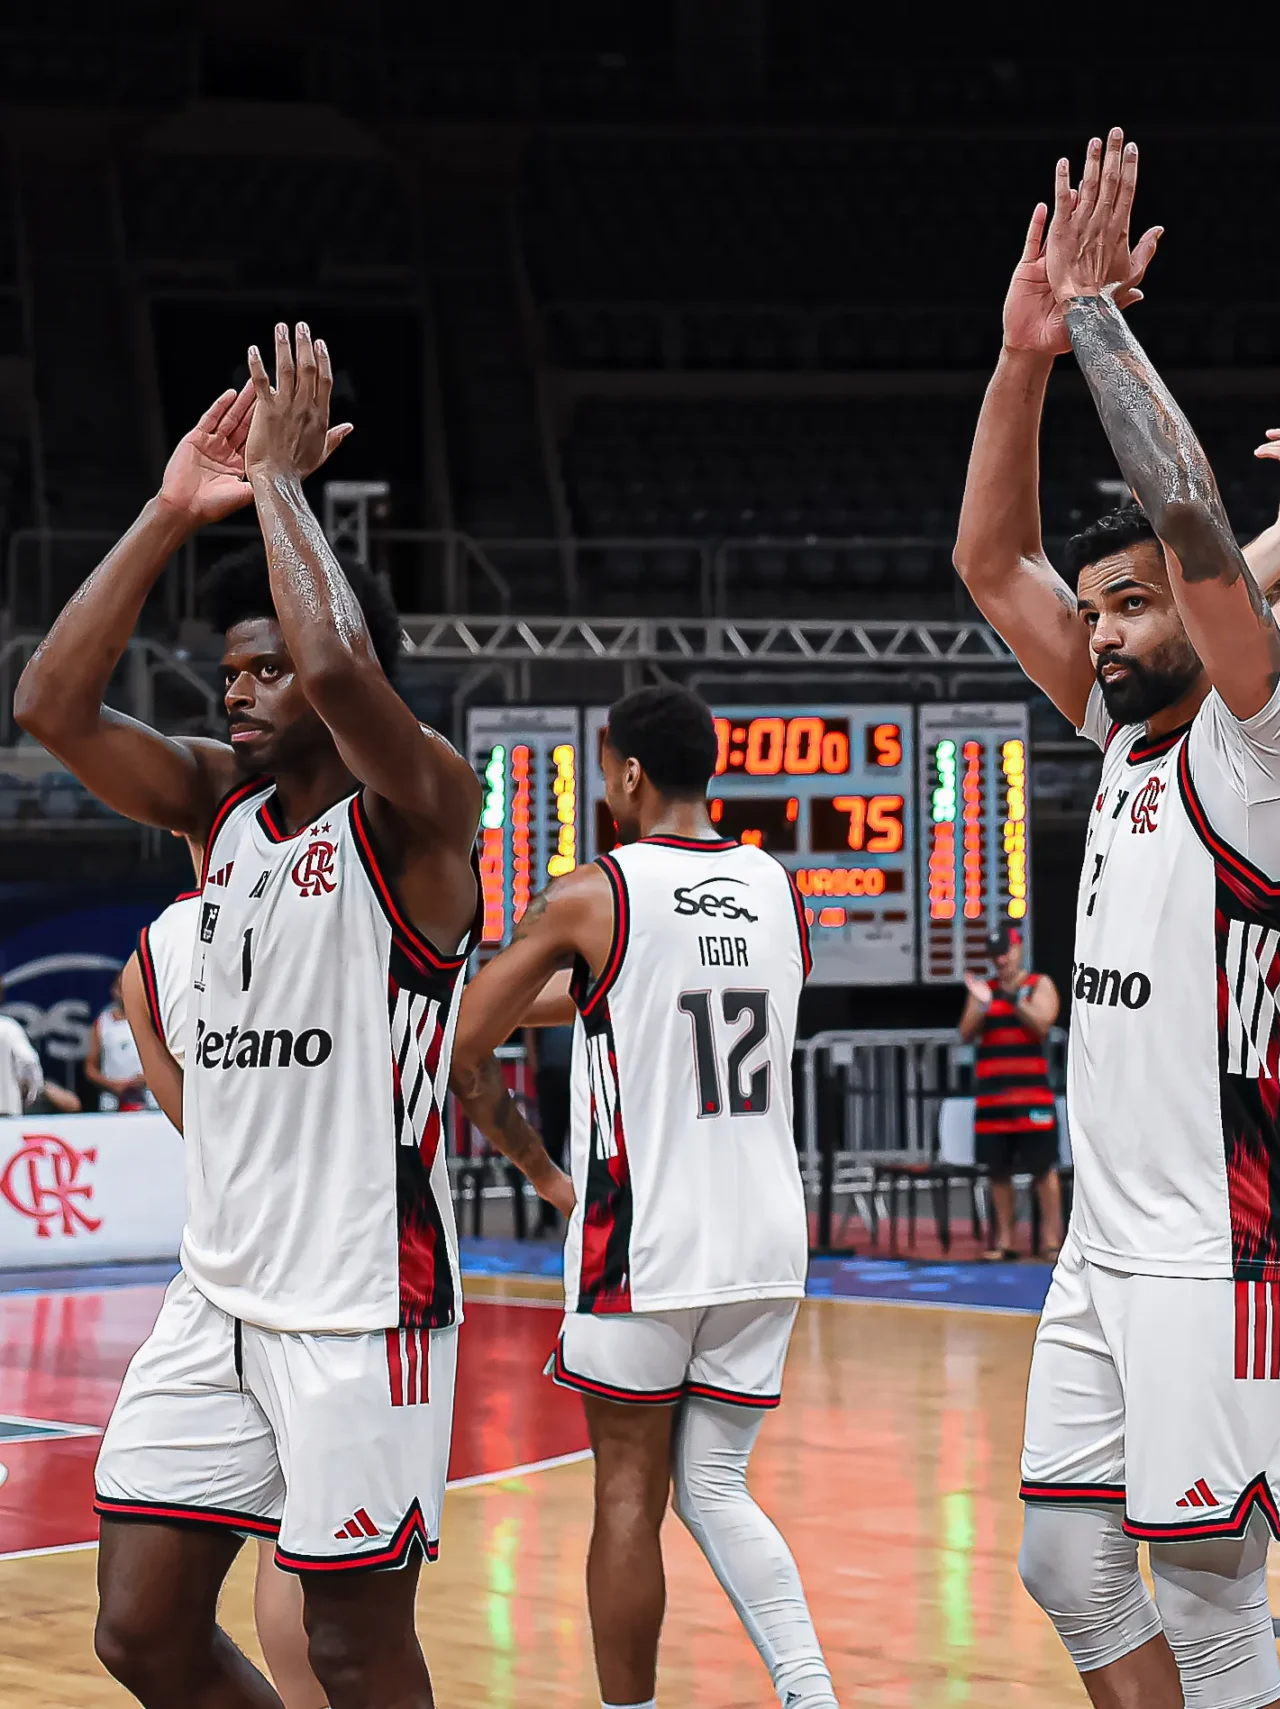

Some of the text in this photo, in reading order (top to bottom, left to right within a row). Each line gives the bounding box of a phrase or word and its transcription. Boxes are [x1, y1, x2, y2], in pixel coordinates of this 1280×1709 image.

[832, 795, 904, 853] 75
[698, 936, 749, 967] IGOR
[677, 987, 771, 1119] 12
